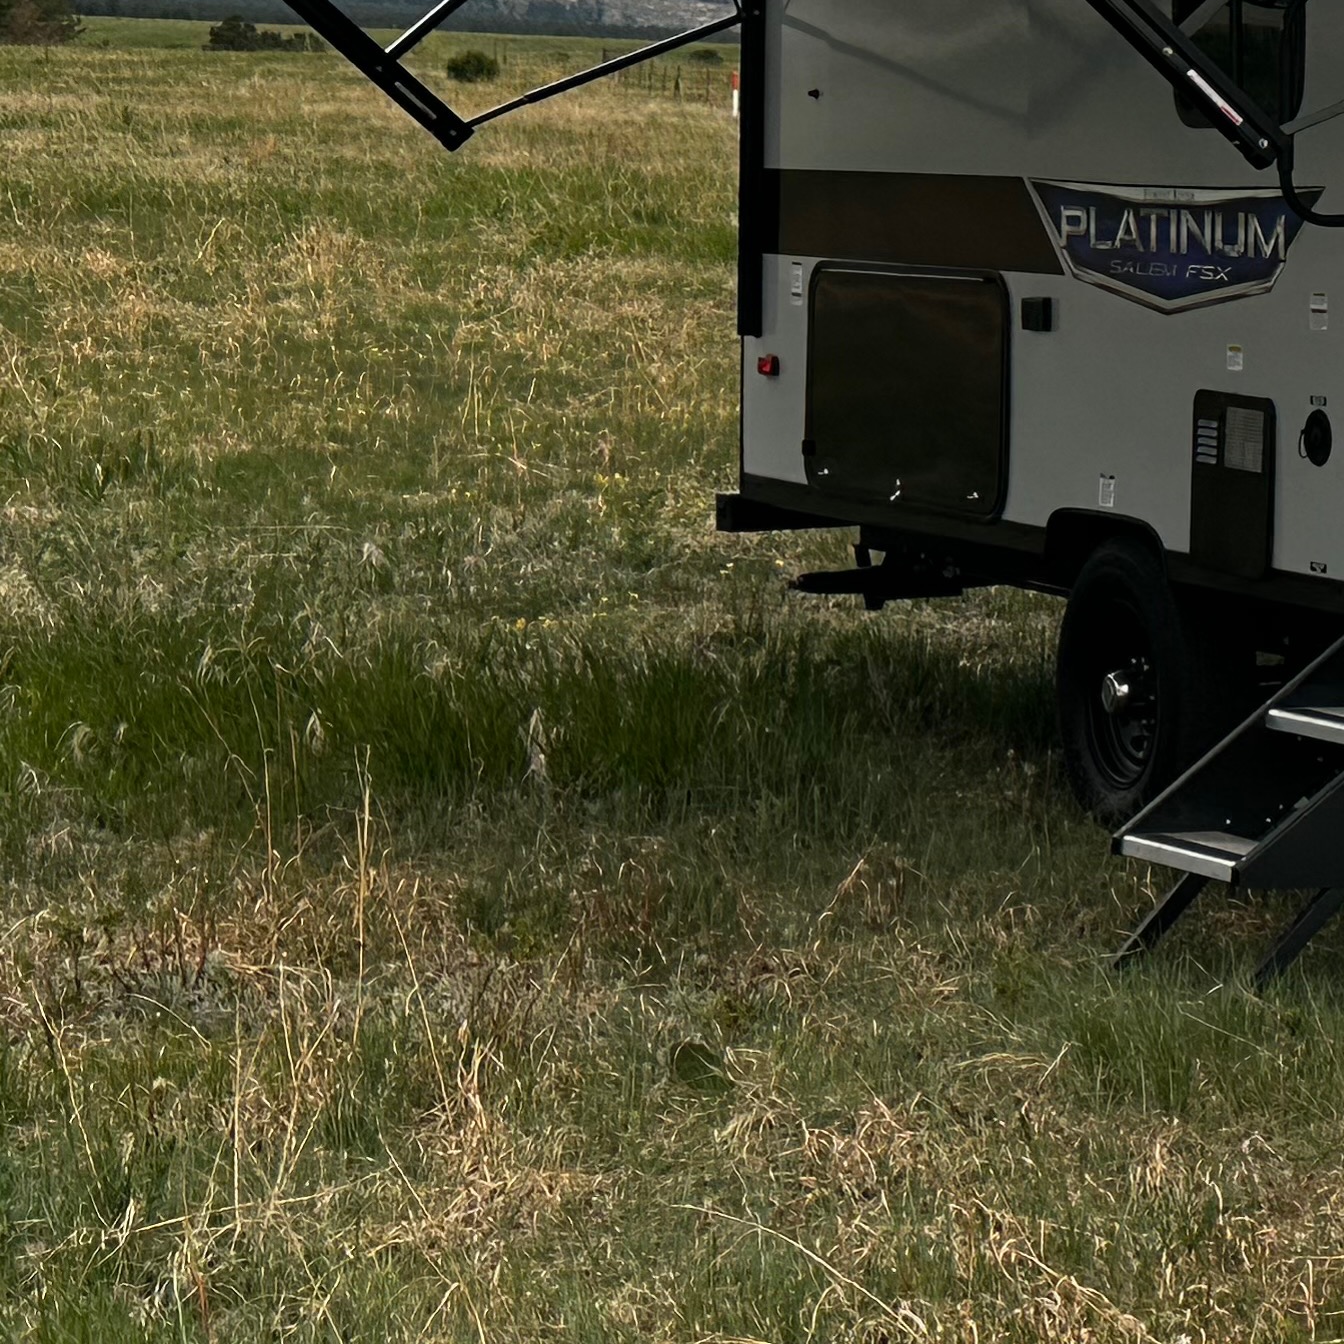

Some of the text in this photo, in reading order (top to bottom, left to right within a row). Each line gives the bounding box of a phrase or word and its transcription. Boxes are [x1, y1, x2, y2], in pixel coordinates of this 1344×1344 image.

[1059, 203, 1287, 261] PLATINUM
[1109, 259, 1233, 282] SALEM FSX
